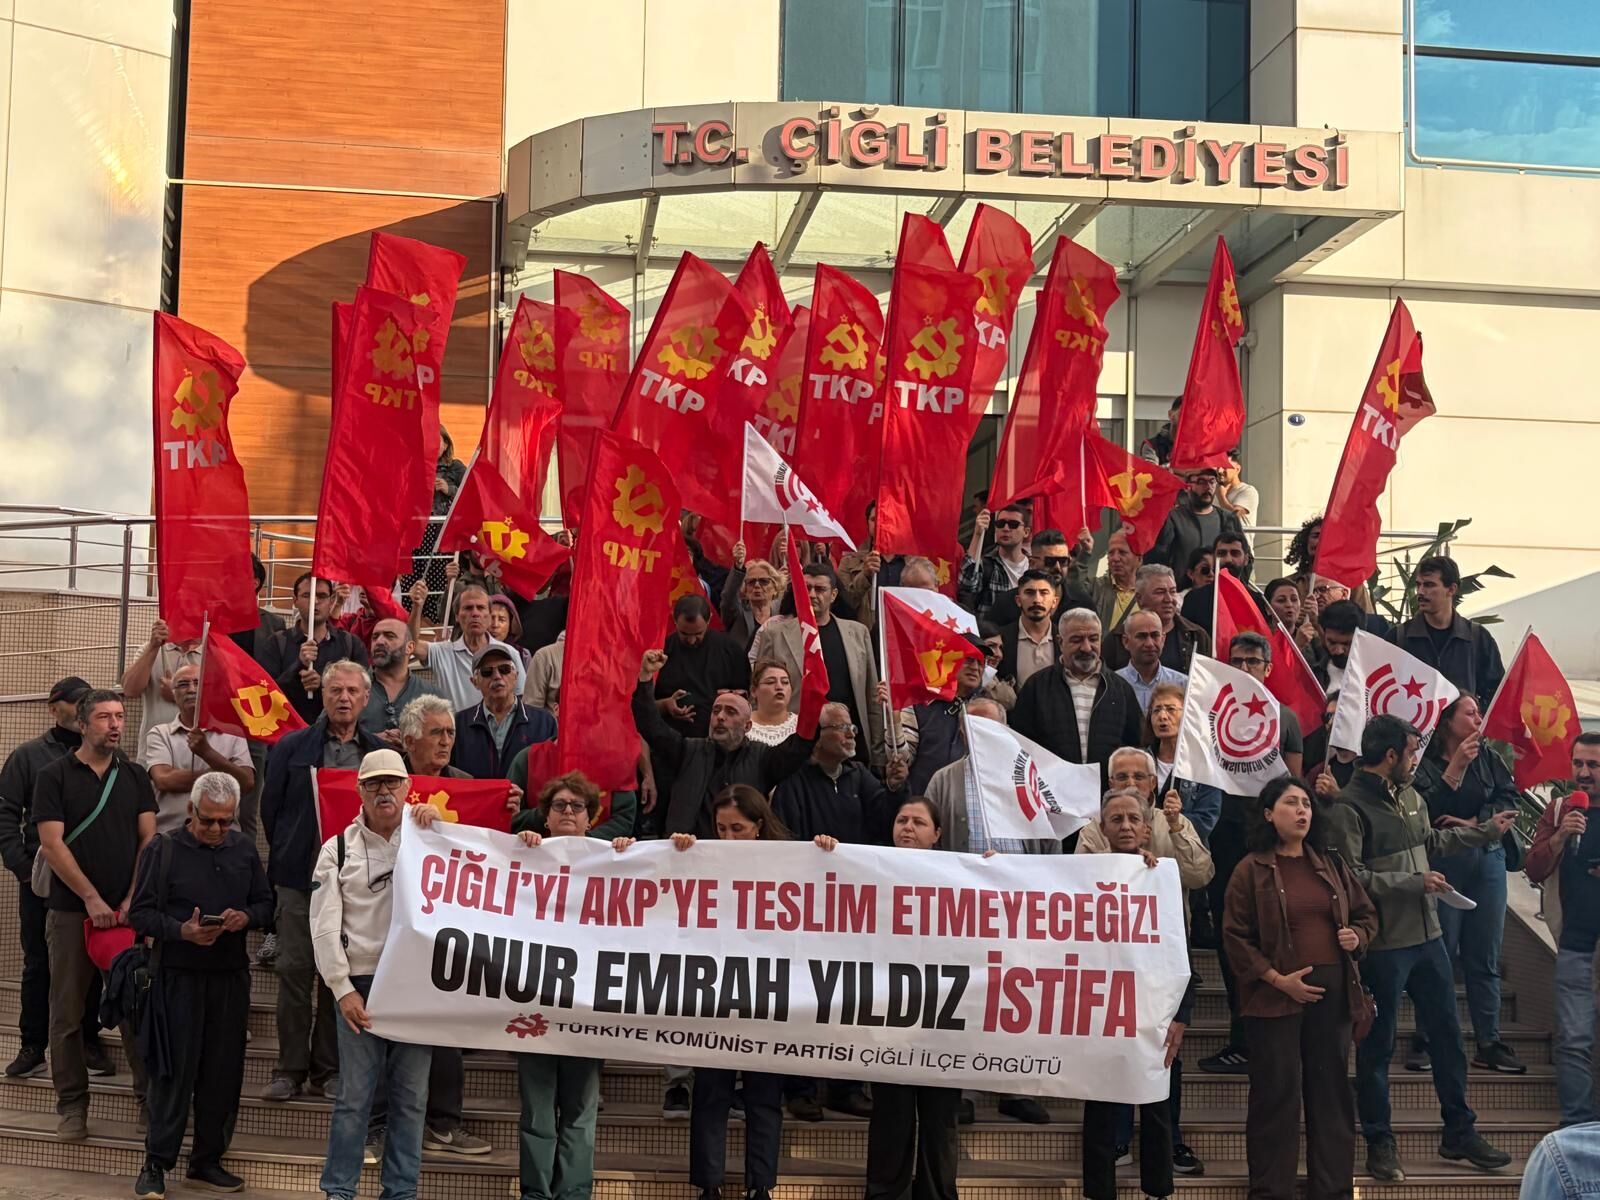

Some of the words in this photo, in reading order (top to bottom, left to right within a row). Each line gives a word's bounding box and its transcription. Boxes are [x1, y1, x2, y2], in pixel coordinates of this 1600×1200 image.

[652, 119, 749, 165] T.C.
[780, 106, 948, 174] ÇİĞLİ
[976, 125, 1350, 188] BELEDİYESİ
[973, 313, 1006, 350] KP
[640, 367, 705, 414] TKP
[726, 355, 768, 387] KP
[809, 373, 874, 404] TKP
[894, 379, 965, 414] TKP
[420, 848, 571, 923] ÇİĞLİ'Yİ
[579, 876, 719, 929] AKP'YE
[732, 871, 877, 934] TESLİM
[892, 881, 1160, 944] ETMEYECEĞİZ!
[430, 927, 579, 1009] ONUR
[592, 950, 790, 1022] EMRAH
[808, 958, 970, 1031] YILDIZ
[983, 950, 1137, 1038] İSTİFA
[555, 1021, 648, 1041] TÜRKİYE
[655, 1030, 768, 1055] KOMÜNİST
[773, 1042, 854, 1062] PARTİSİ
[859, 1047, 914, 1066] ÇİĞLİ
[920, 1049, 967, 1072] İLÇE
[972, 1052, 1062, 1075] ÖRGÜTÜ
